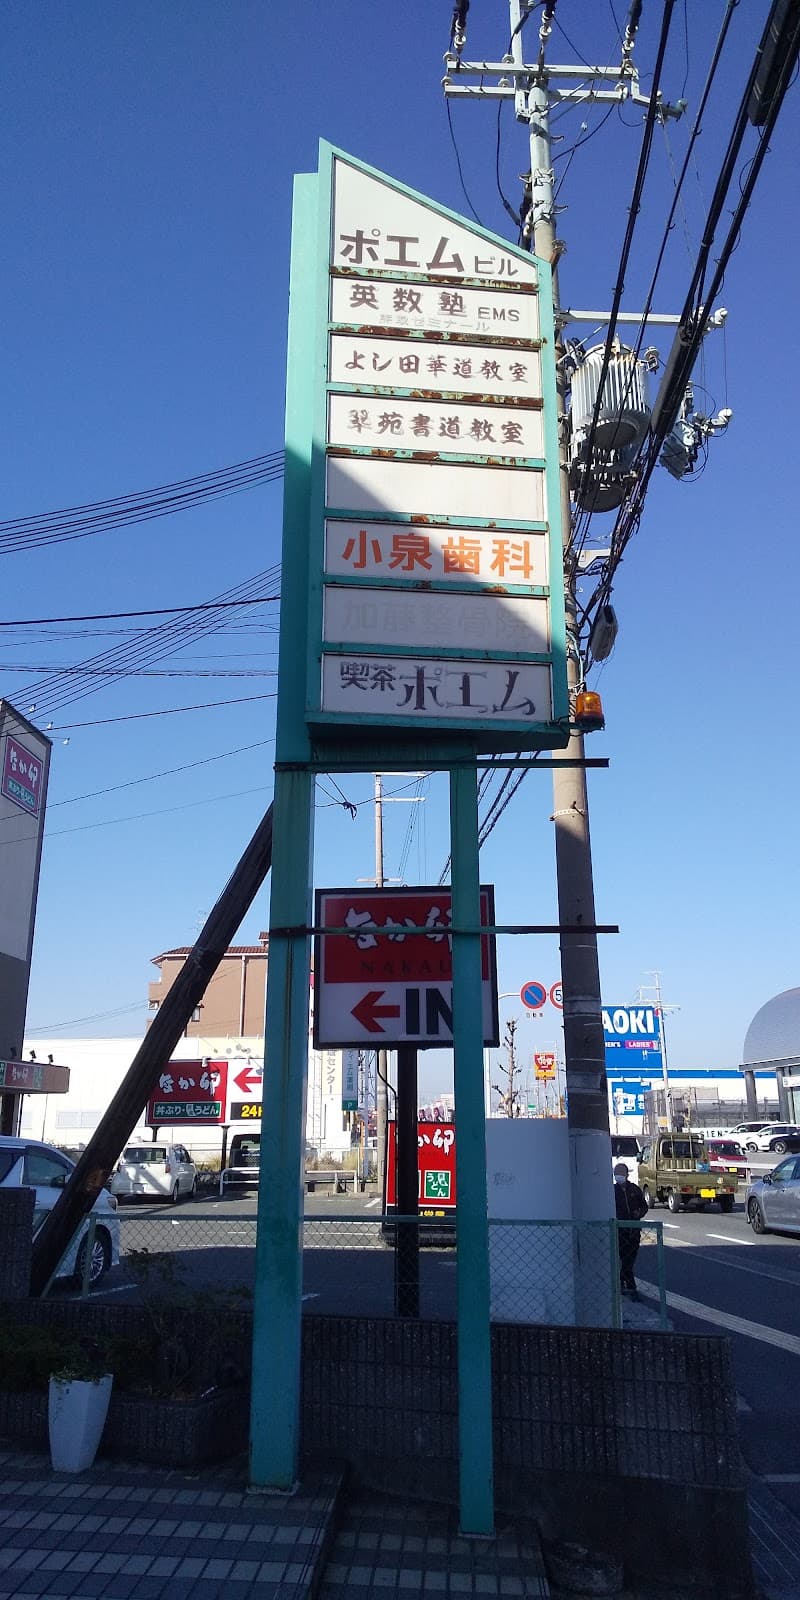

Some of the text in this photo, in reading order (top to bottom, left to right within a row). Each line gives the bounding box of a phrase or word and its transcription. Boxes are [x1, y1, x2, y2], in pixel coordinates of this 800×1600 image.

[340, 228, 519, 277] ポエム ビル
[350, 284, 520, 322] 英数塾 EMS
[345, 350, 529, 383] よし田華道教室
[348, 409, 525, 445] 翠苑書道教室
[342, 530, 534, 579] 小泉歯科
[341, 661, 536, 715] 喫茶 ポエム
[602, 1009, 655, 1034] AOKI
[159, 1072, 221, 1097] なか卯
